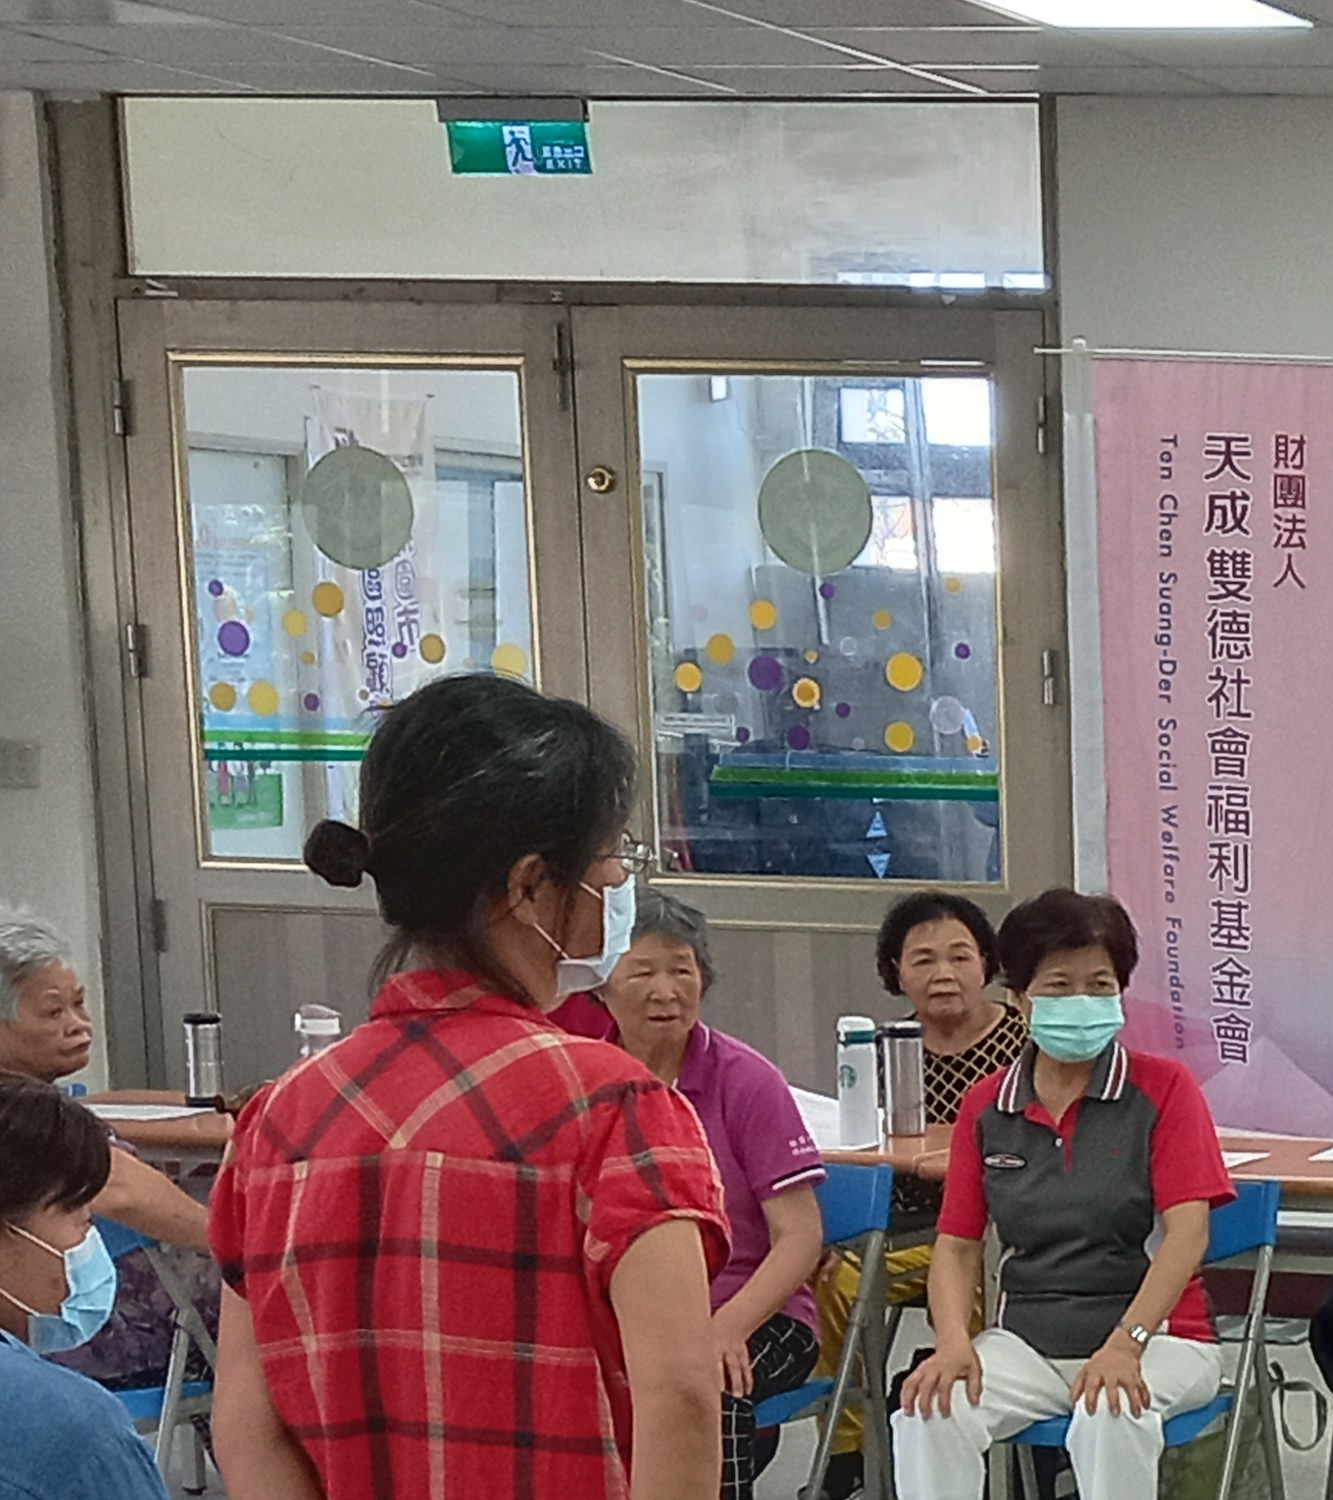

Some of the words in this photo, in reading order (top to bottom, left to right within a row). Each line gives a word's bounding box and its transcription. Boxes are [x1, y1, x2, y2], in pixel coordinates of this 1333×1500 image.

[1159, 494, 1178, 558] Chen
[1273, 434, 1307, 590] 財團法人
[1154, 572, 1178, 704] Suang-Der
[1157, 717, 1179, 792] Social
[1203, 433, 1252, 1065] 天成雙德社會福利基金會
[1160, 804, 1181, 904] Welfare
[1164, 915, 1187, 1049] Foundation
